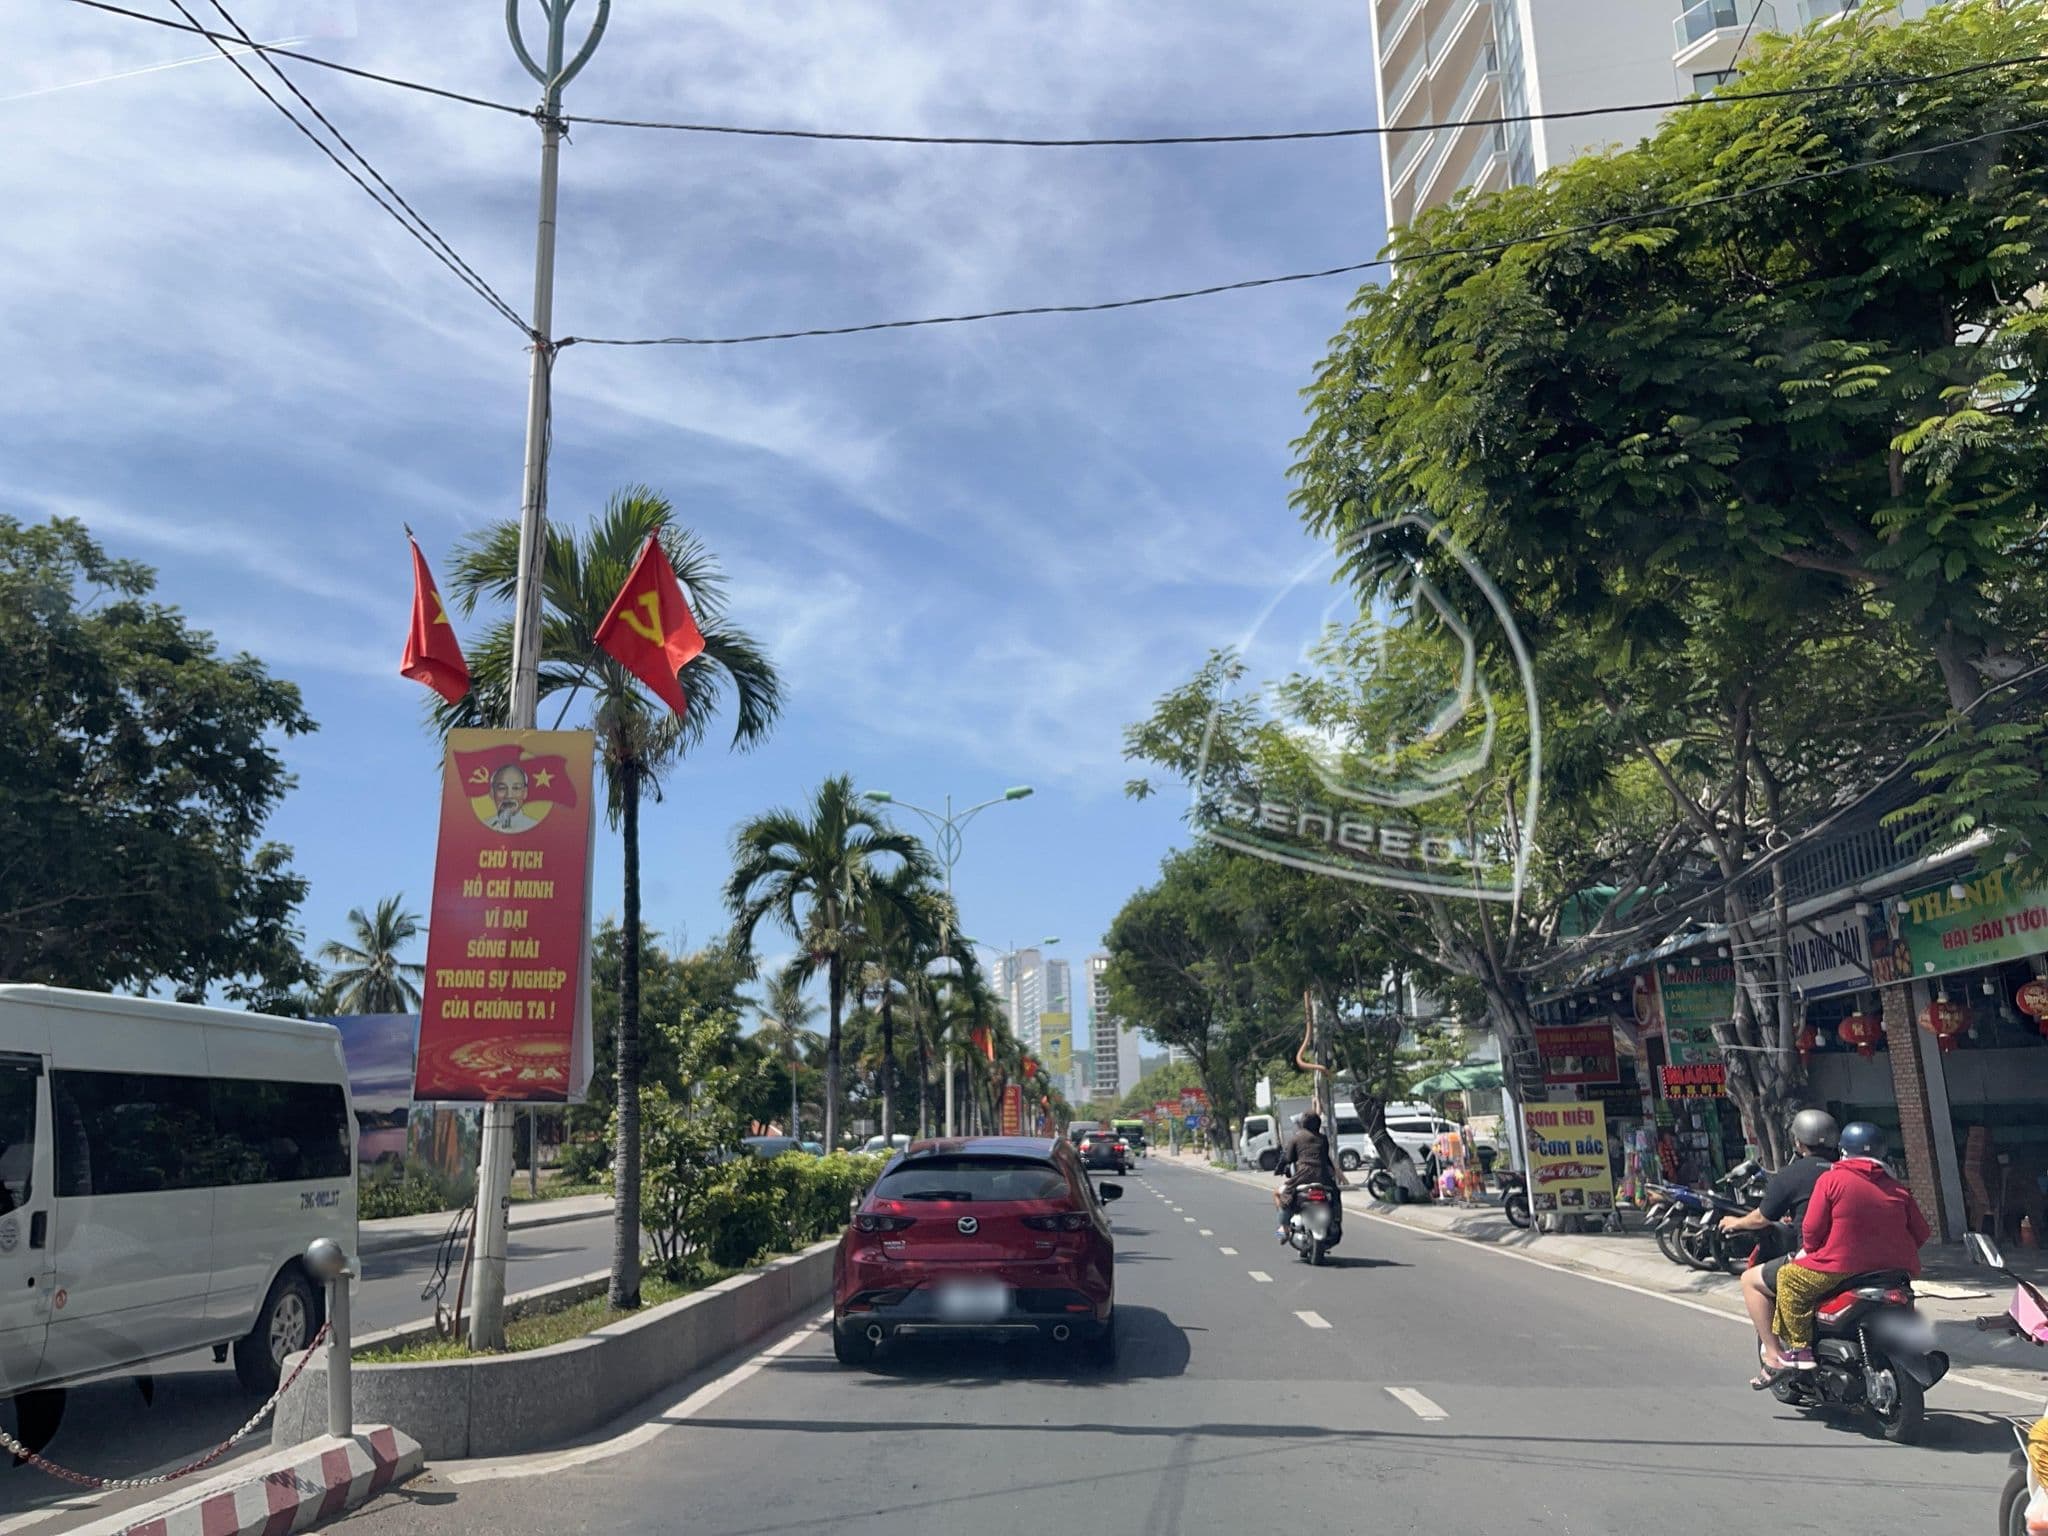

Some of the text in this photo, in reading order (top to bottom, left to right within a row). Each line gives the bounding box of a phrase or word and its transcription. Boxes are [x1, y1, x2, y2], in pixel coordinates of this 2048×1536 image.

[479, 845, 543, 872] CHỦ TỊCH
[463, 872, 554, 899] HỒ CHÍ MINH
[1909, 868, 2004, 924] THANH
[467, 932, 506, 958] SỐNG
[436, 967, 567, 992] TRONG SỰ NGHIỆP
[442, 995, 469, 1019] CỦA
[474, 997, 522, 1019] CHÚNG
[527, 1001, 546, 1019] TA
